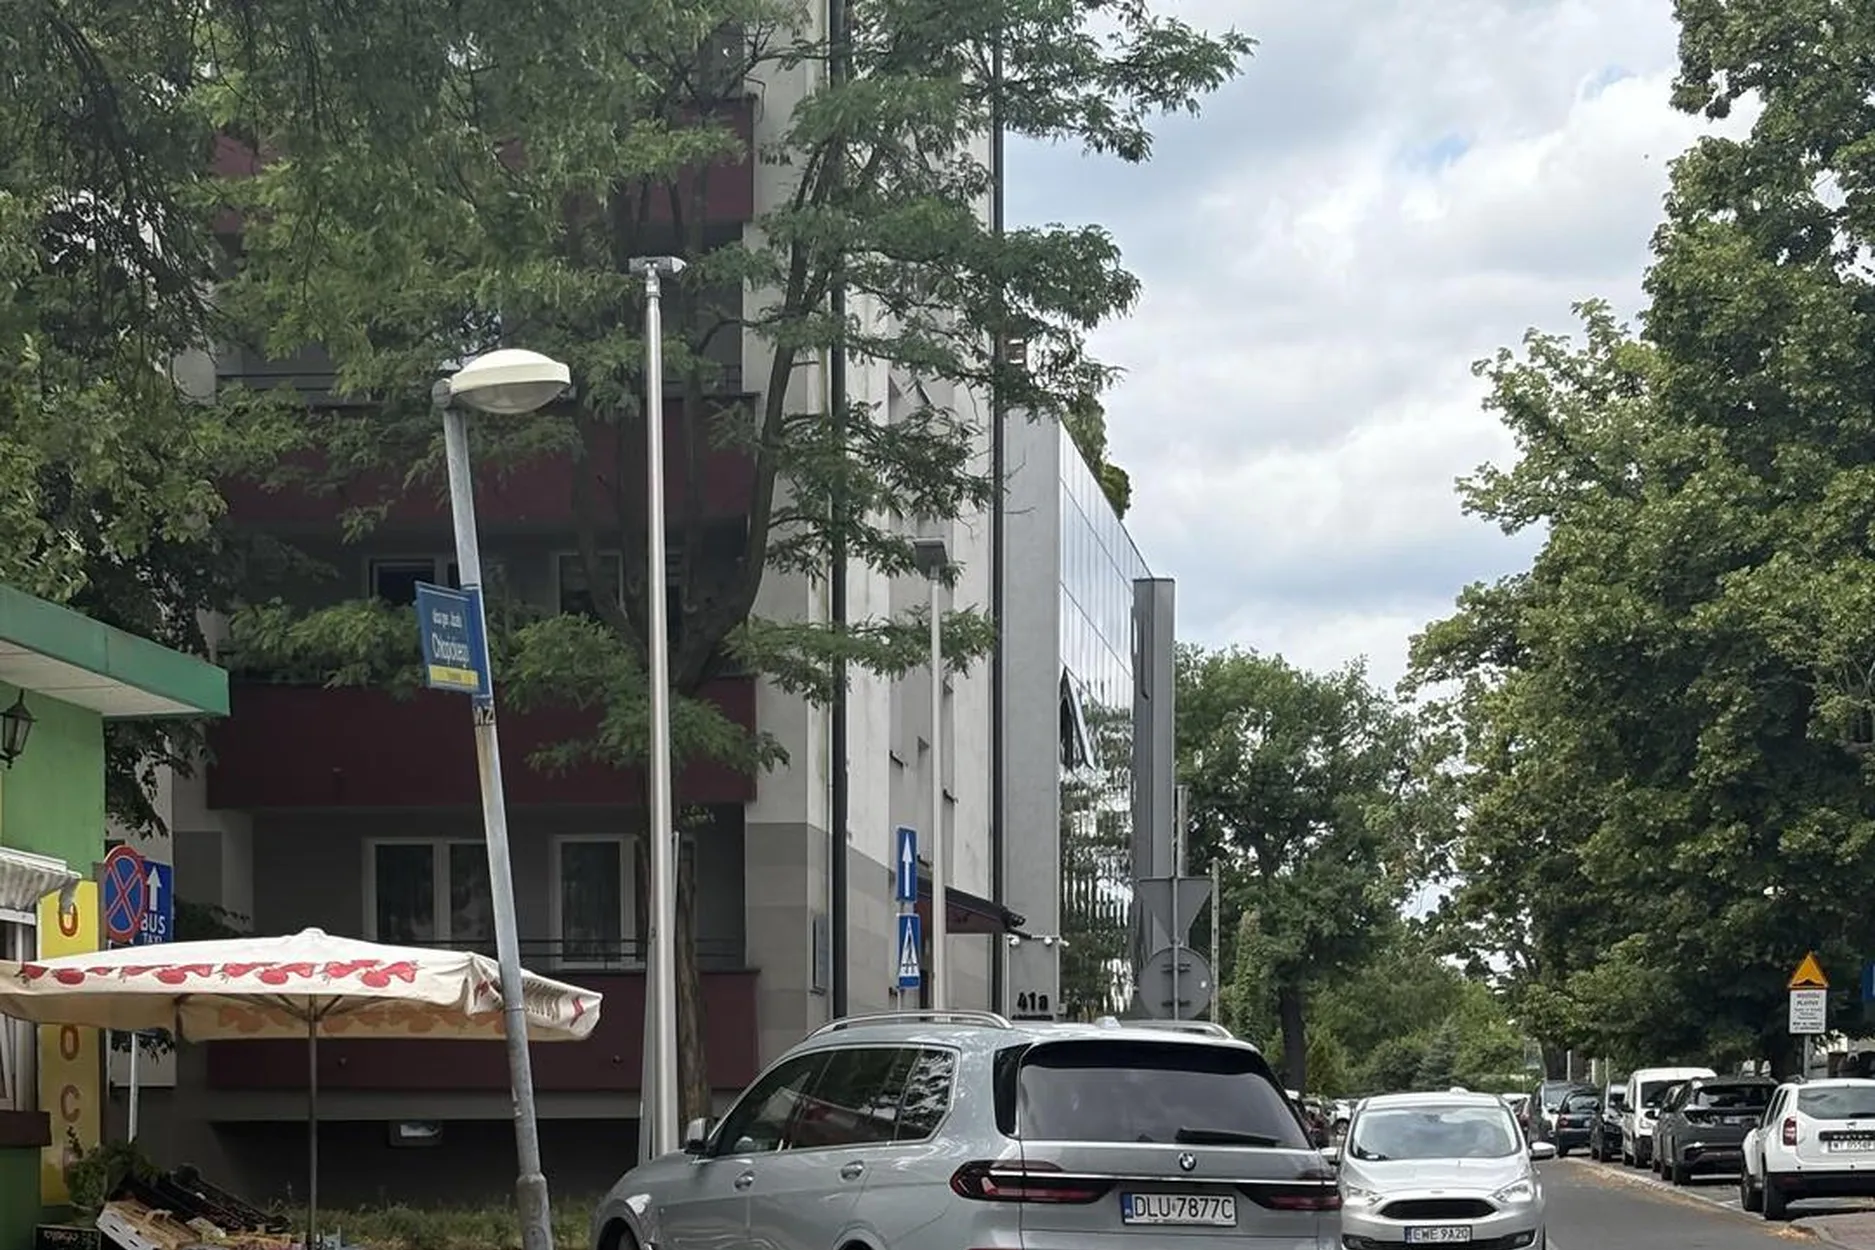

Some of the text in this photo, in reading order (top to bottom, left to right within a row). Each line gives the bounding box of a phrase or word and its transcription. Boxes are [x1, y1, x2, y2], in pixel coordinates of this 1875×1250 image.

[140, 911, 166, 934] BUS
[1017, 992, 1048, 1011] 41a
[1134, 1195, 1233, 1219] DLU 7877C
